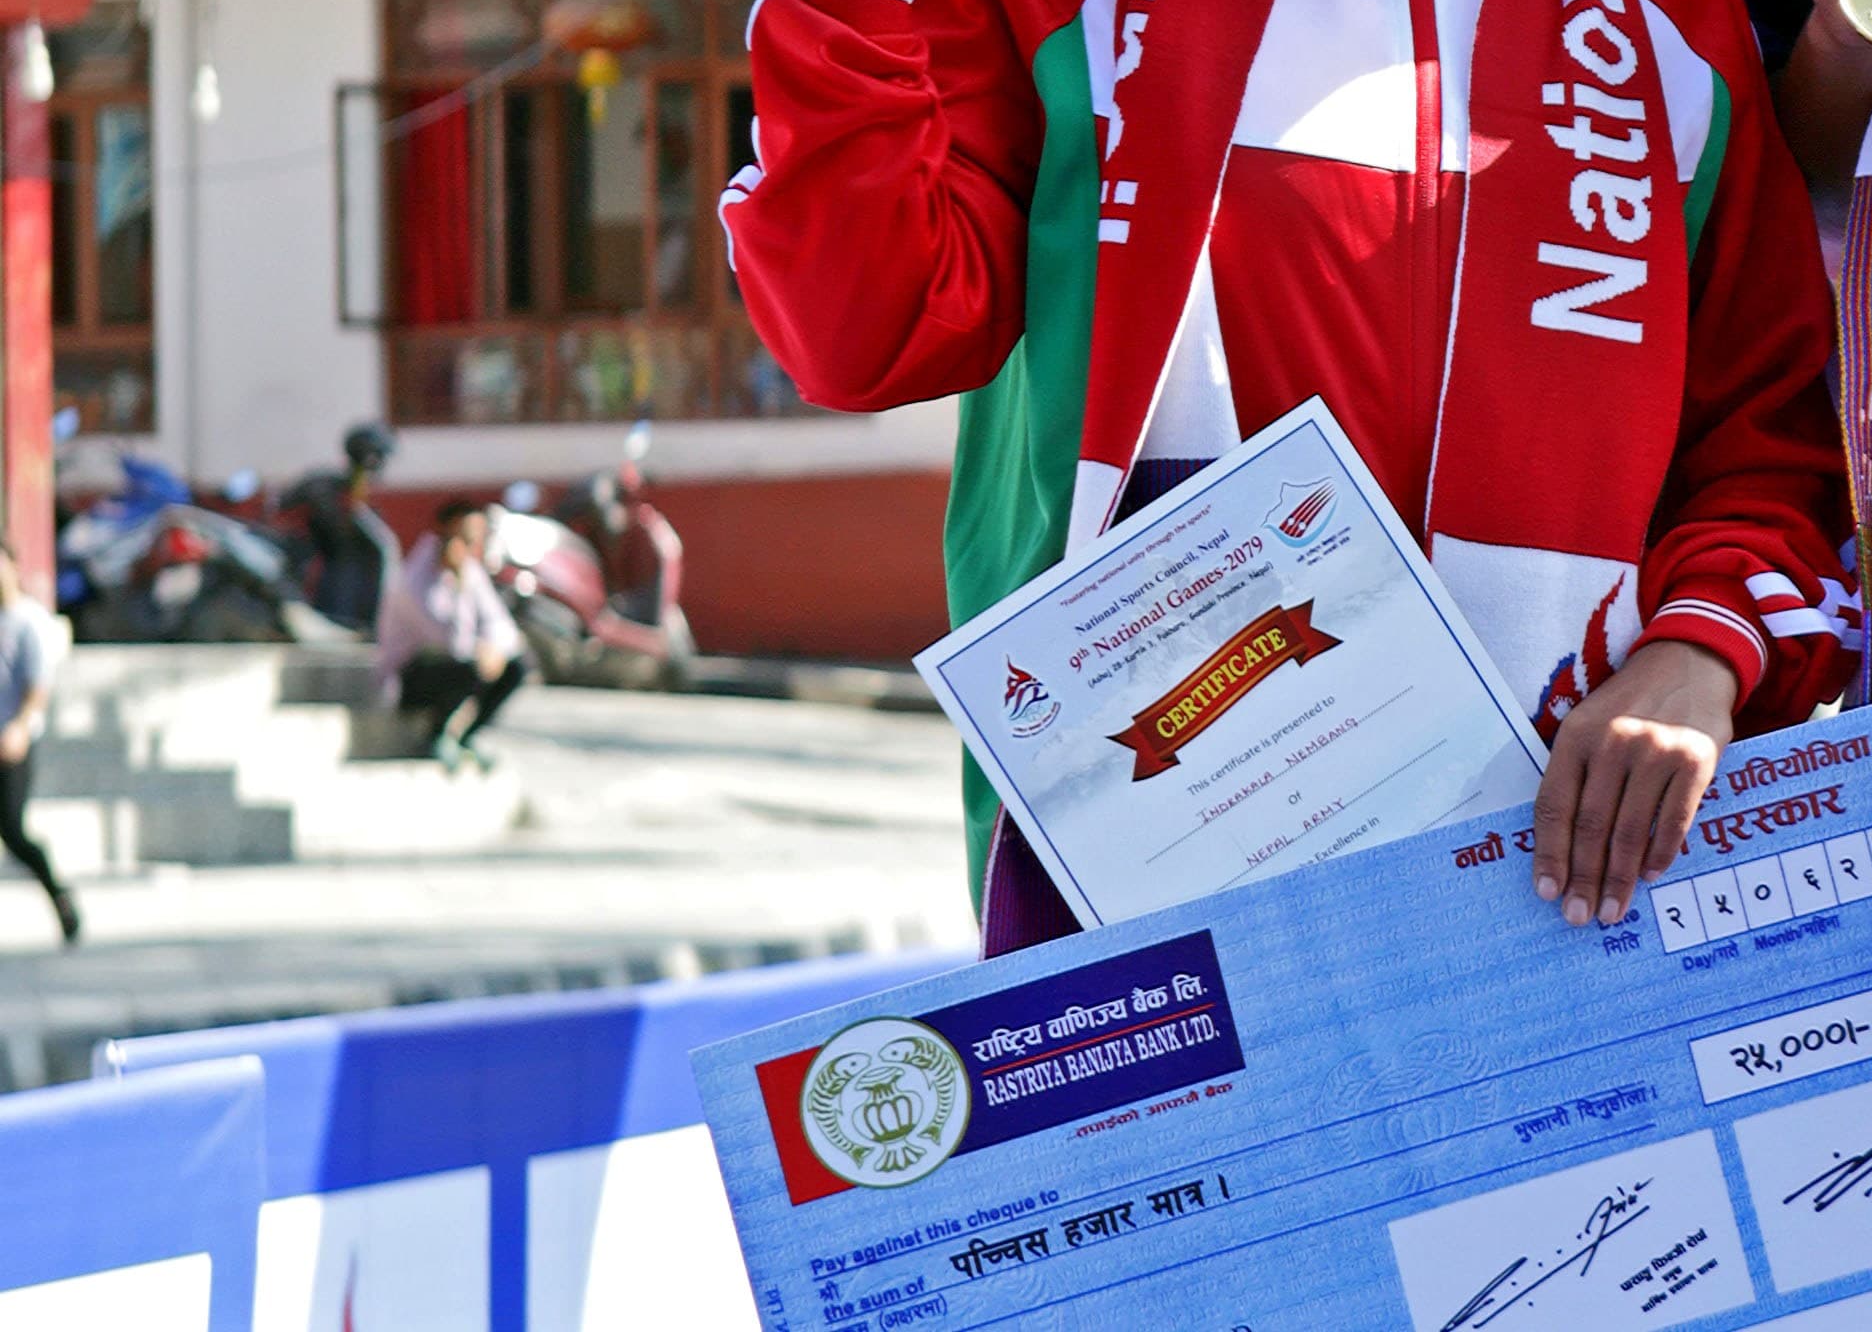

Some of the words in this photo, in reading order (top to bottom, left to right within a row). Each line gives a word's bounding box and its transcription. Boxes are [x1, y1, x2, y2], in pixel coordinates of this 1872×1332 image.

[1073, 600, 1121, 636] National
[1122, 579, 1155, 609] Sports
[1154, 551, 1200, 584] Council,
[1198, 528, 1231, 555] Nepal
[1098, 564, 1127, 590] national
[1127, 548, 1146, 568] unity
[1146, 531, 1173, 555] through
[1173, 522, 1187, 537] the
[1068, 646, 1091, 674] 9th
[1092, 601, 1166, 658] National
[1166, 535, 1264, 610] Games-2079
[1155, 626, 1288, 740] CERTIFICATE
[1187, 776, 1211, 797] This
[1210, 746, 1262, 784] certificate
[1261, 738, 1271, 752] is
[1271, 706, 1322, 747] presented
[1322, 694, 1336, 709] to
[1246, 833, 1295, 868] NEPAL
[1302, 797, 1346, 832] ARMY
[1287, 791, 1302, 806] Of
[1698, 783, 1848, 856] पुरस्कार
[1314, 823, 1368, 864] Excellence
[1602, 930, 1642, 958] मिति
[1681, 942, 1741, 973] Day/गते
[1753, 912, 1842, 951] Month/महिना
[972, 1022, 1044, 1062] राष्ट्रिय
[1046, 997, 1129, 1039] वाणिज्य
[1171, 973, 1209, 1003] लि.
[982, 1067, 1067, 1108] RASTRIYA
[1064, 1040, 1137, 1083] BANIJYA
[1135, 1022, 1183, 1061] BANK
[1180, 1013, 1221, 1048] LTD.
[1513, 1104, 1571, 1142] भुक्तानी
[810, 1254, 847, 1276] Pay
[852, 1228, 922, 1267] against
[925, 1218, 960, 1241] this
[965, 1199, 1037, 1233] cheque
[1039, 1187, 1060, 1205] to
[948, 1226, 1052, 1281] पच्चिस
[1062, 1202, 1137, 1249] हजार
[1146, 1179, 1206, 1220] मात्र
[819, 1280, 842, 1303] श्री
[823, 1301, 855, 1322] the
[859, 1287, 902, 1312] sum
[905, 1276, 927, 1295] of
